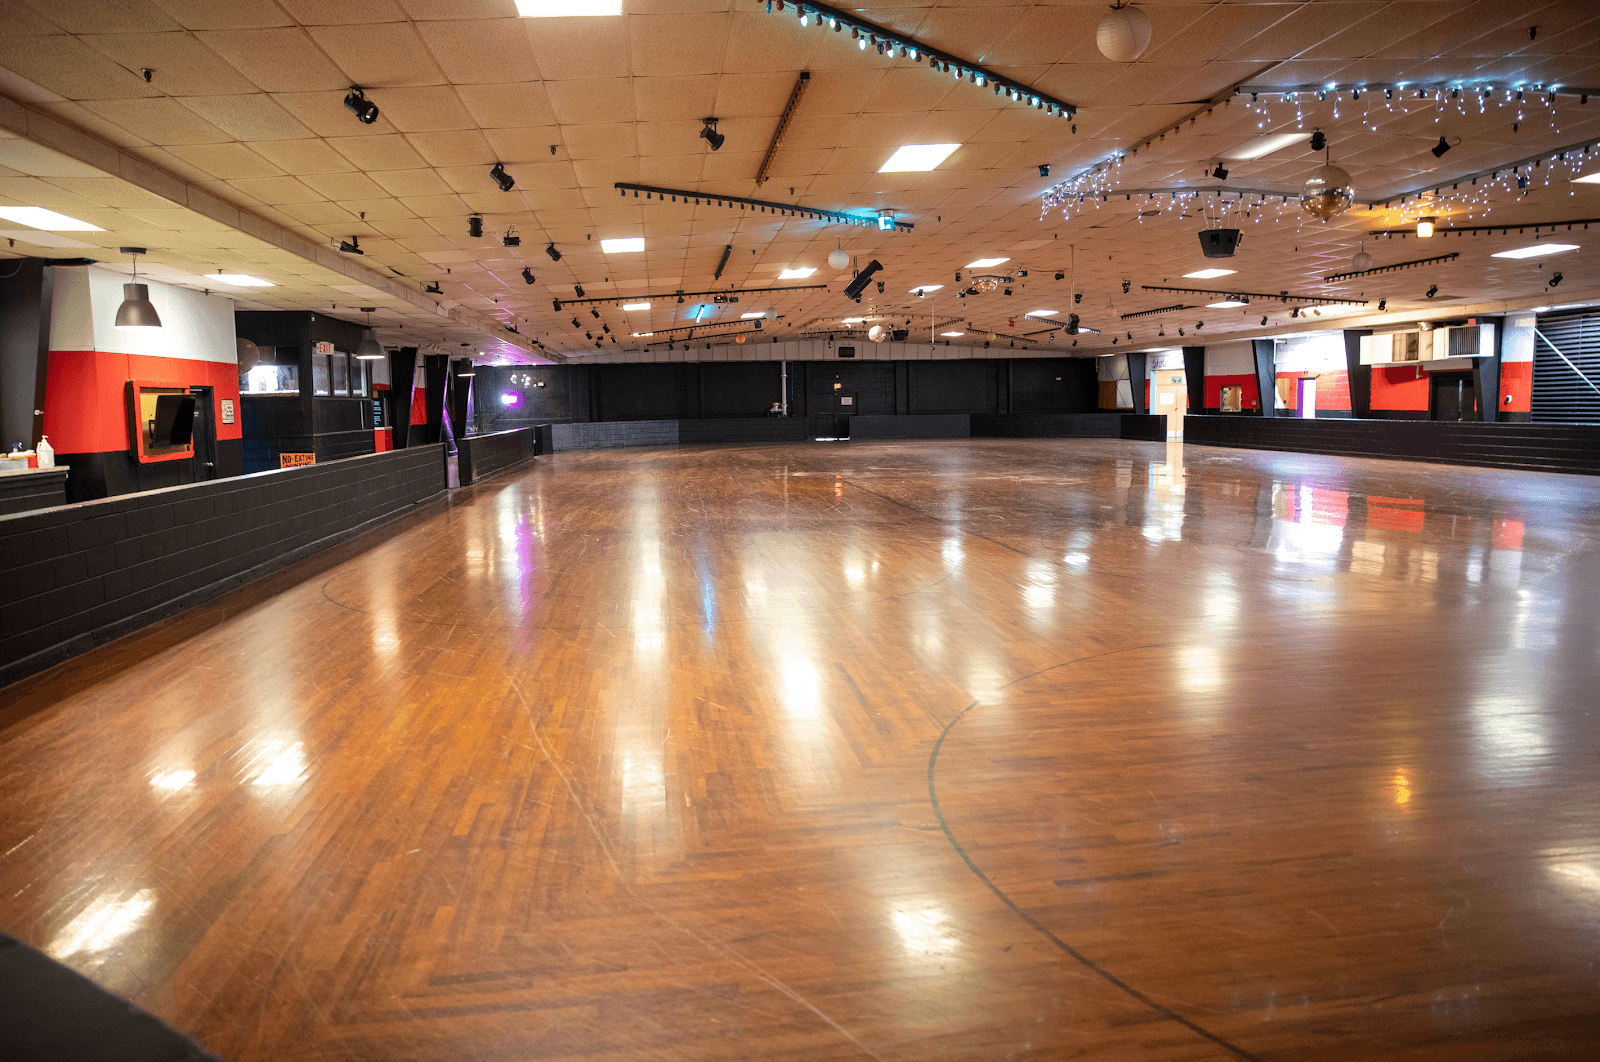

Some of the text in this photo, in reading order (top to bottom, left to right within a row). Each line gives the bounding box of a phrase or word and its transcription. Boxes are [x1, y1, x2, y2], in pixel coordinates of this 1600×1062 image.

[319, 343, 331, 353] EXIT
[282, 454, 314, 464] NO EATING
